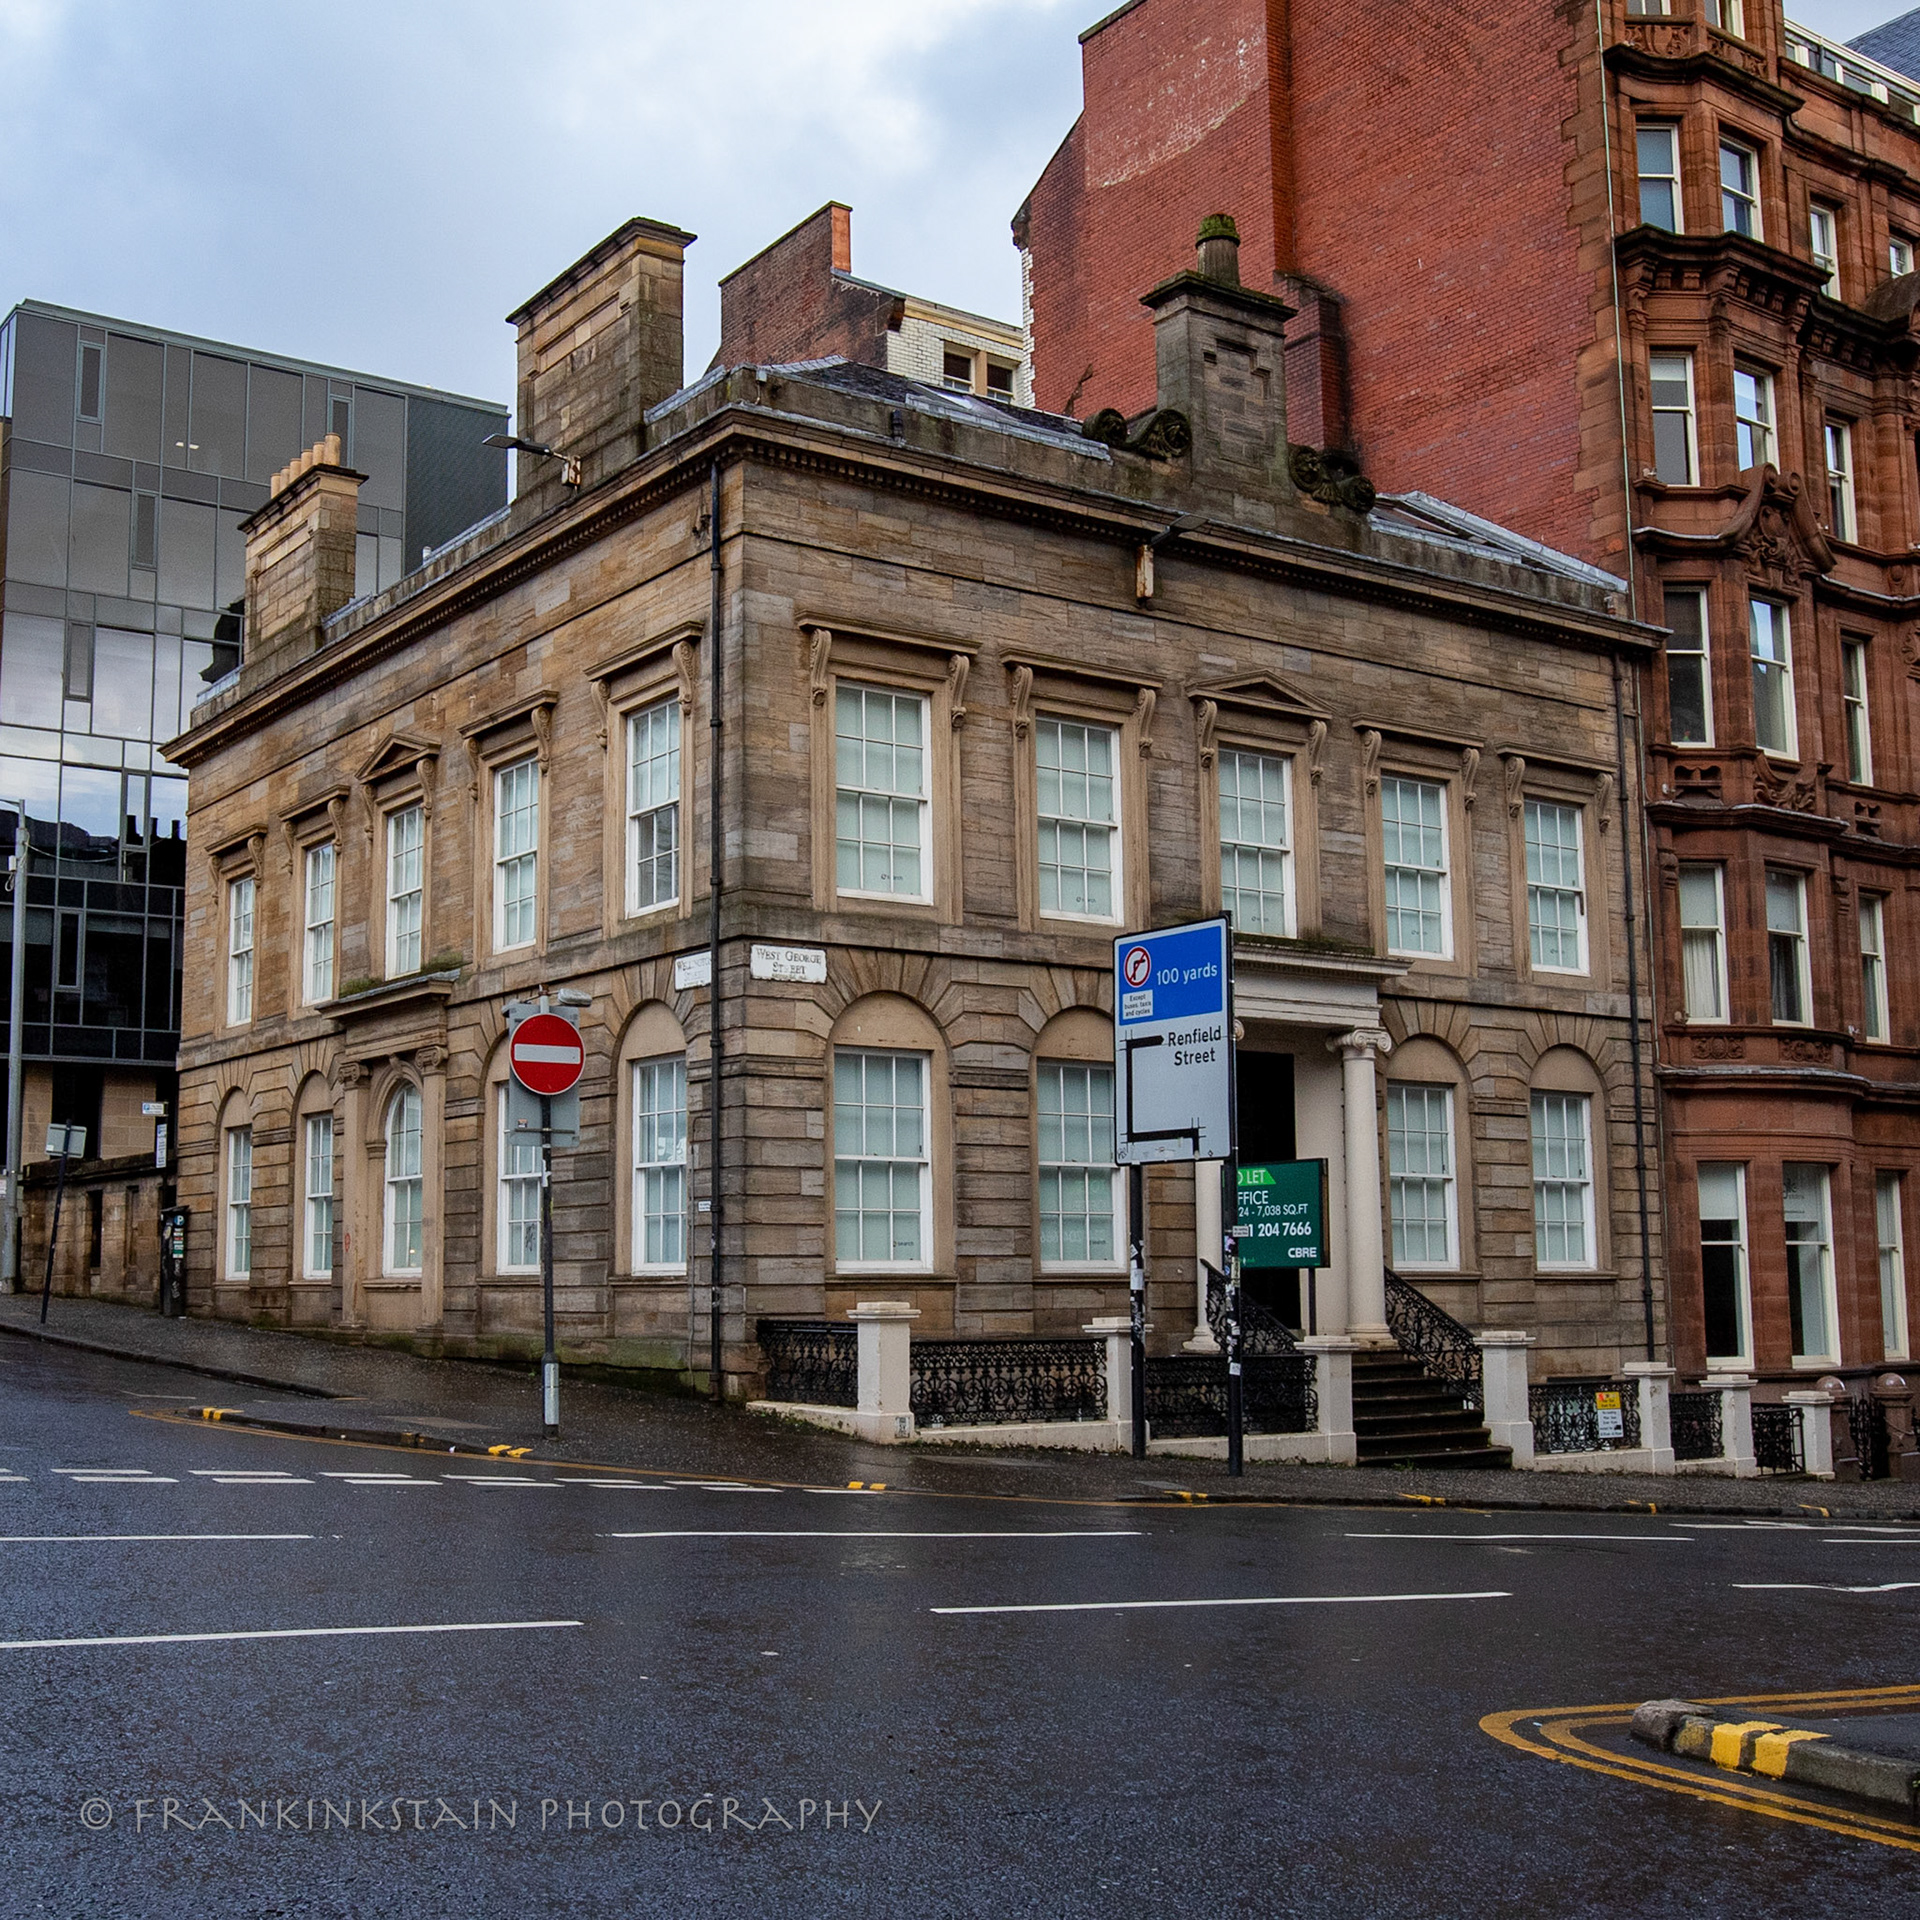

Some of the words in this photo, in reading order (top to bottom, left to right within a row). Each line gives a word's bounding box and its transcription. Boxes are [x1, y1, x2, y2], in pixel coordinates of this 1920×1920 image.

[756, 947, 781, 961] WEST
[785, 950, 822, 965] GEORGE
[772, 961, 805, 975] STEET
[1156, 967, 1179, 986] 100
[1183, 962, 1218, 985] yards
[1129, 994, 1146, 1002] Except
[1125, 1009, 1135, 1017] and
[1135, 1008, 1151, 1017] cycles
[1168, 1025, 1221, 1047] Renfield
[1174, 1047, 1216, 1066] Street
[1246, 1169, 1267, 1185] LET
[1237, 1190, 1269, 1206] FFICE
[1238, 1206, 1250, 1218] 24
[1257, 1205, 1281, 1218] 7,038
[1282, 1203, 1309, 1216] SQ.FT
[1257, 1222, 1280, 1238] 204
[1282, 1221, 1312, 1237] 7666
[1287, 1246, 1318, 1259] CBRE
